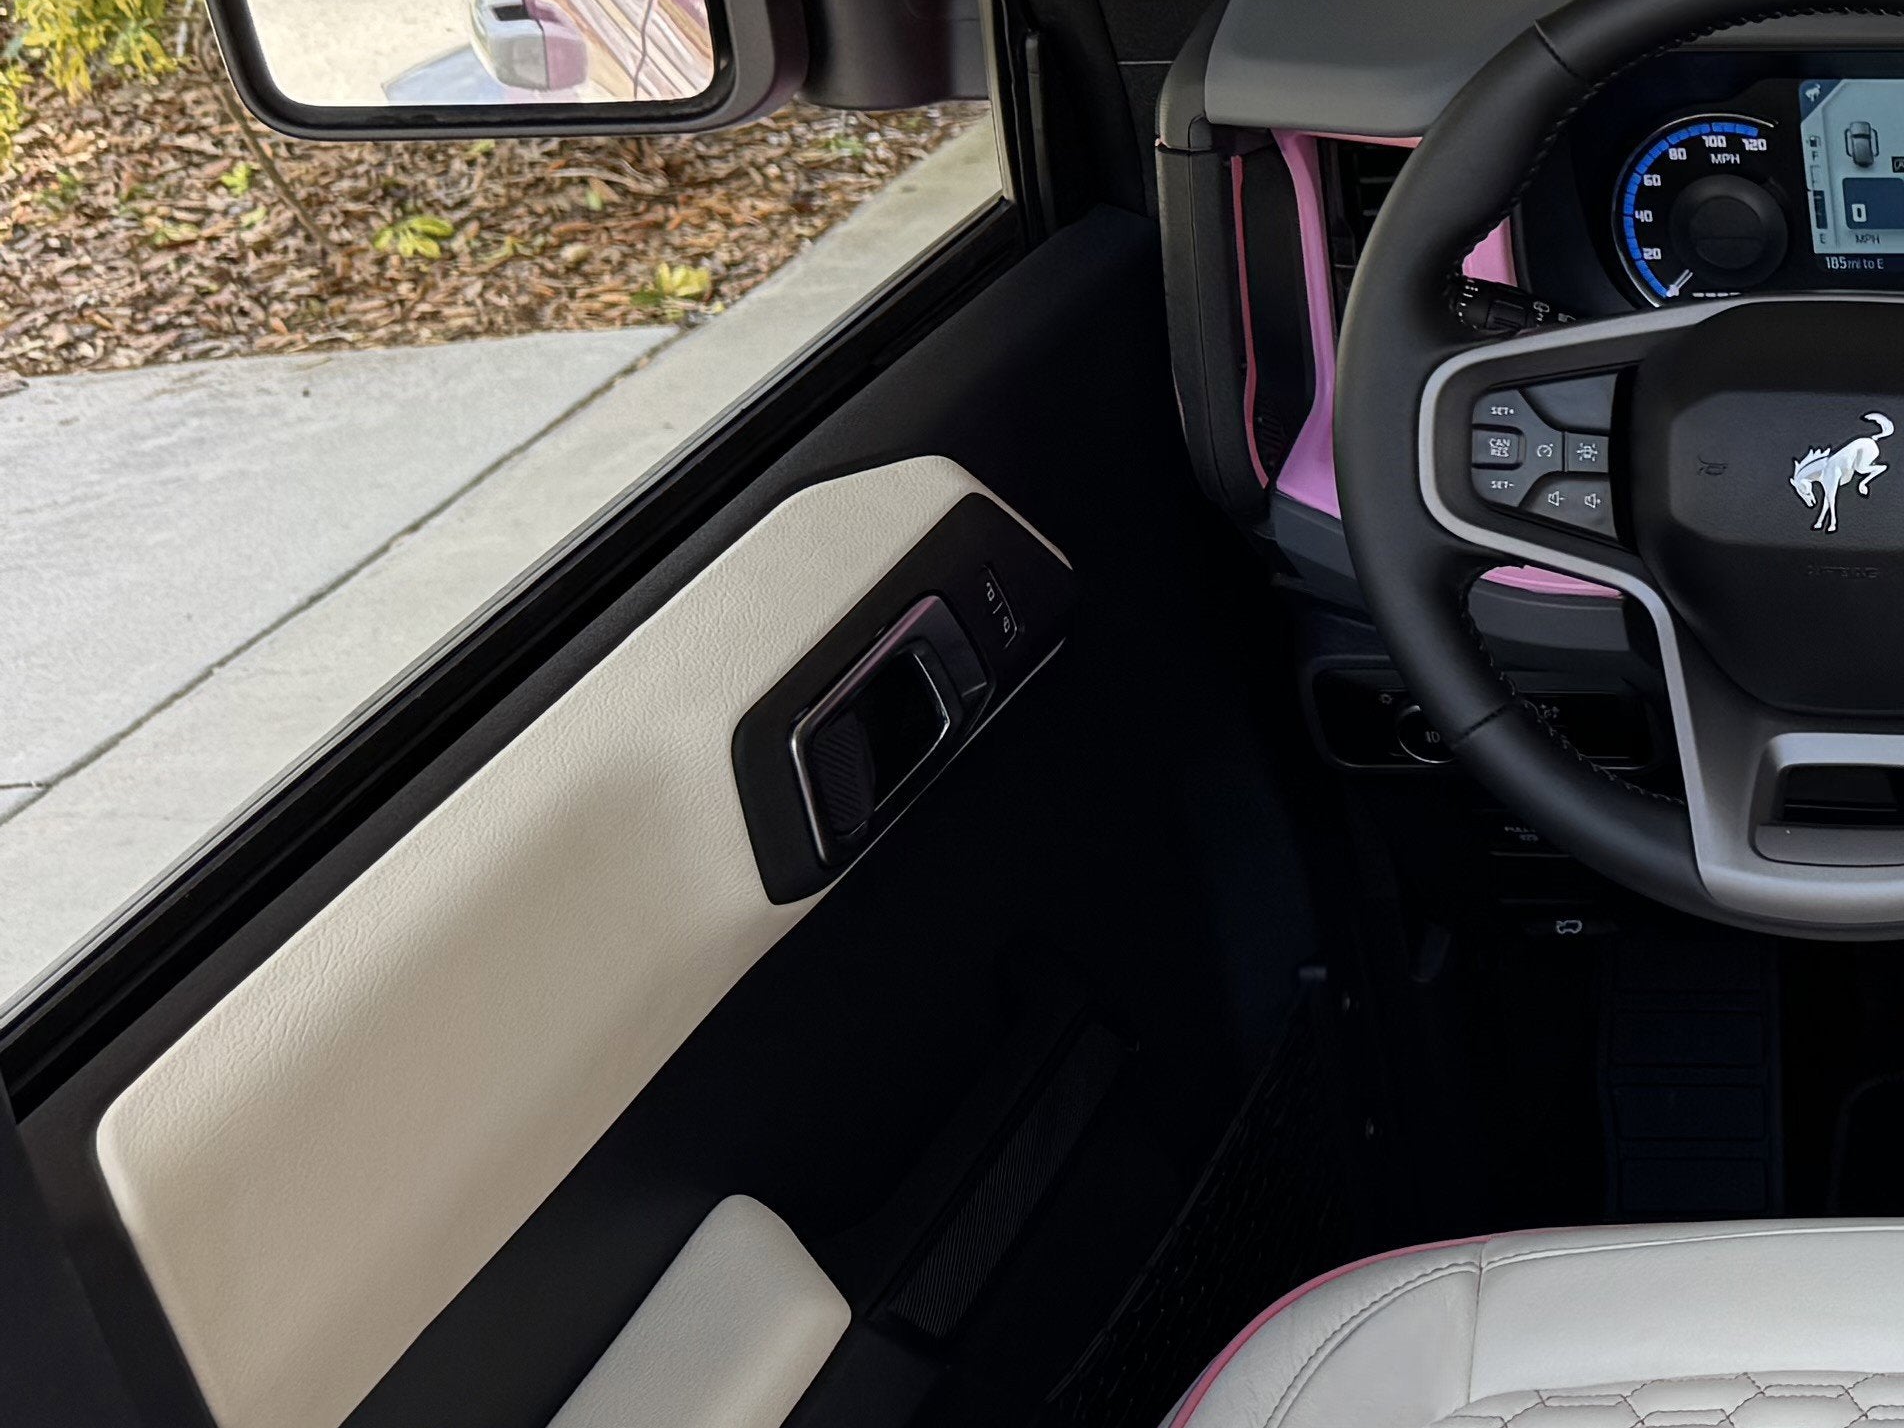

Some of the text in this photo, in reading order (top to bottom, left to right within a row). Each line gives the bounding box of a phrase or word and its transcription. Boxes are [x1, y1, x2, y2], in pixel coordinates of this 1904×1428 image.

[1702, 136, 1727, 148] 100
[1742, 139, 1767, 151] 120
[1668, 148, 1687, 160] 80
[1710, 153, 1740, 164] MPH
[1644, 174, 1661, 186] 60
[1635, 210, 1653, 222] 40
[1855, 234, 1880, 244] MPH
[1643, 248, 1661, 260] 20
[1863, 258, 1875, 269] to
[1877, 258, 1884, 269] E
[1489, 438, 1511, 447] CAN
